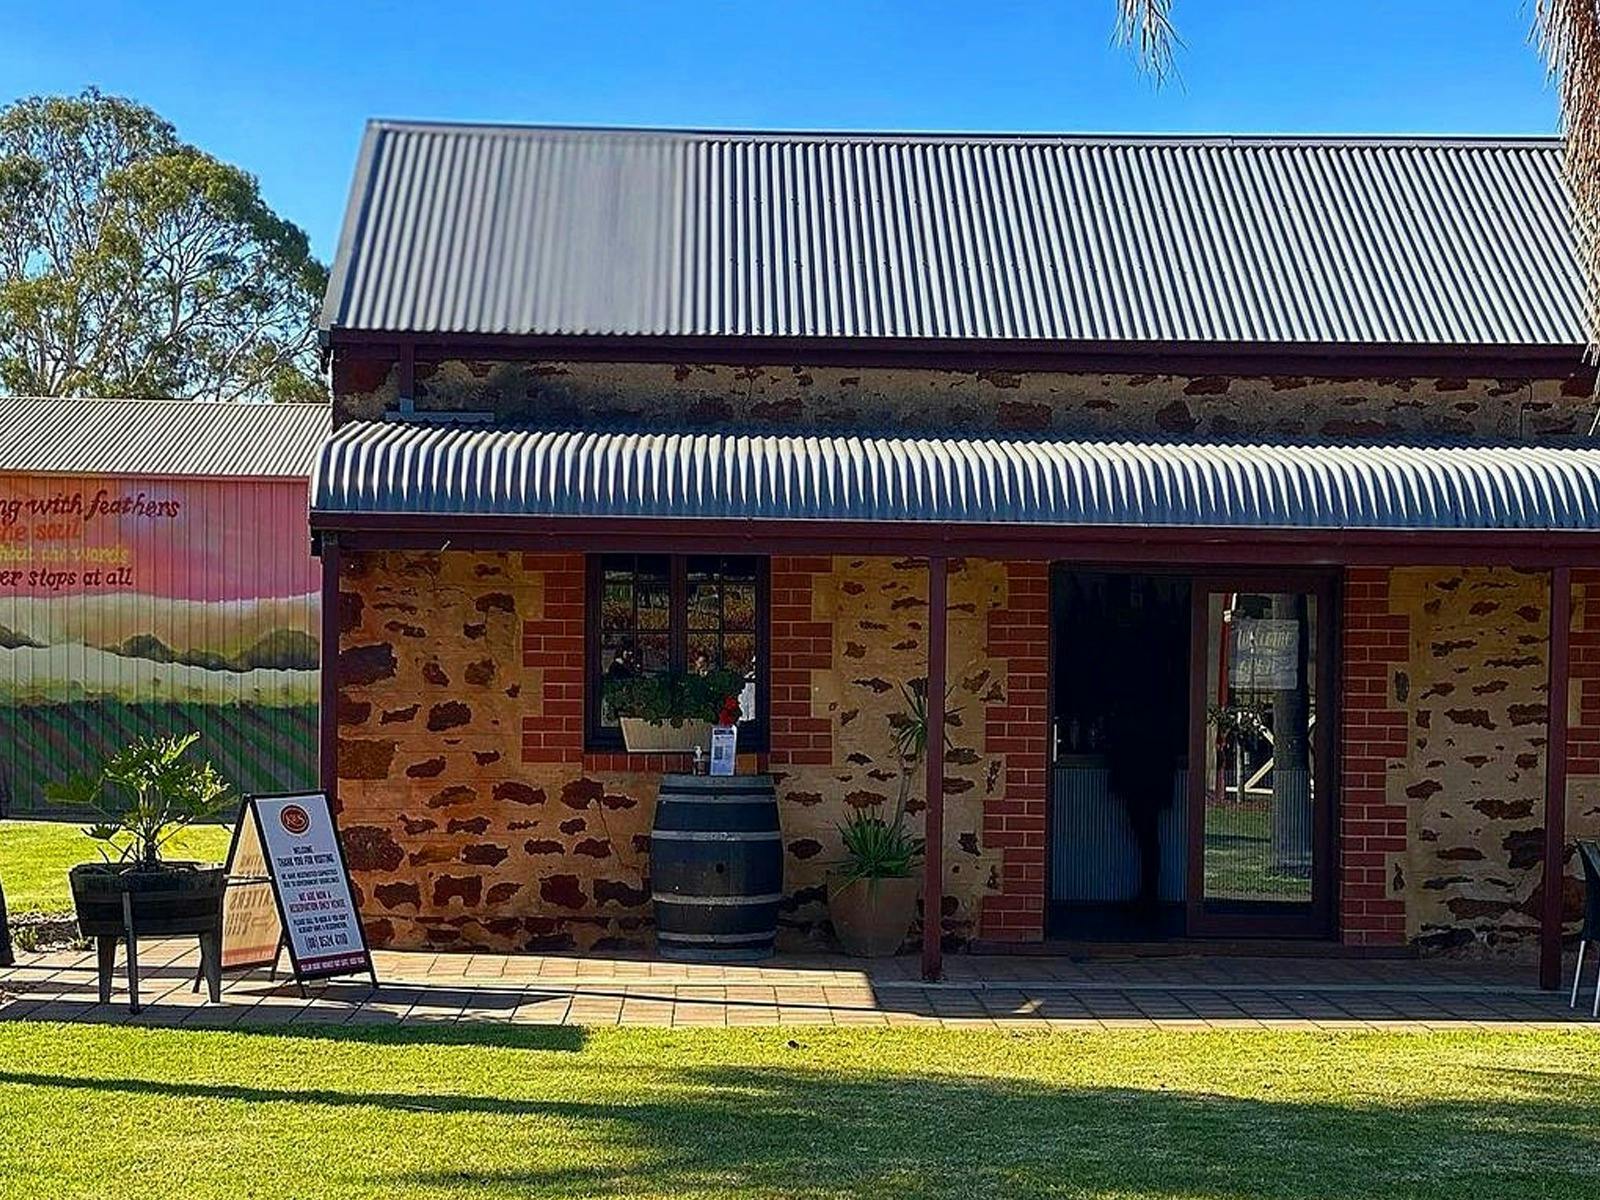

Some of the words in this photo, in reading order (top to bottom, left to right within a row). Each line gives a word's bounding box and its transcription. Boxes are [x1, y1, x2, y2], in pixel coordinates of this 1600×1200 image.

[25, 491, 83, 516] with
[84, 489, 180, 522] feathers
[36, 522, 82, 540] soul
[28, 568, 77, 590] stops
[83, 570, 101, 586] at
[106, 567, 133, 586] all
[294, 856, 303, 865] YOU
[304, 855, 313, 864] FOR
